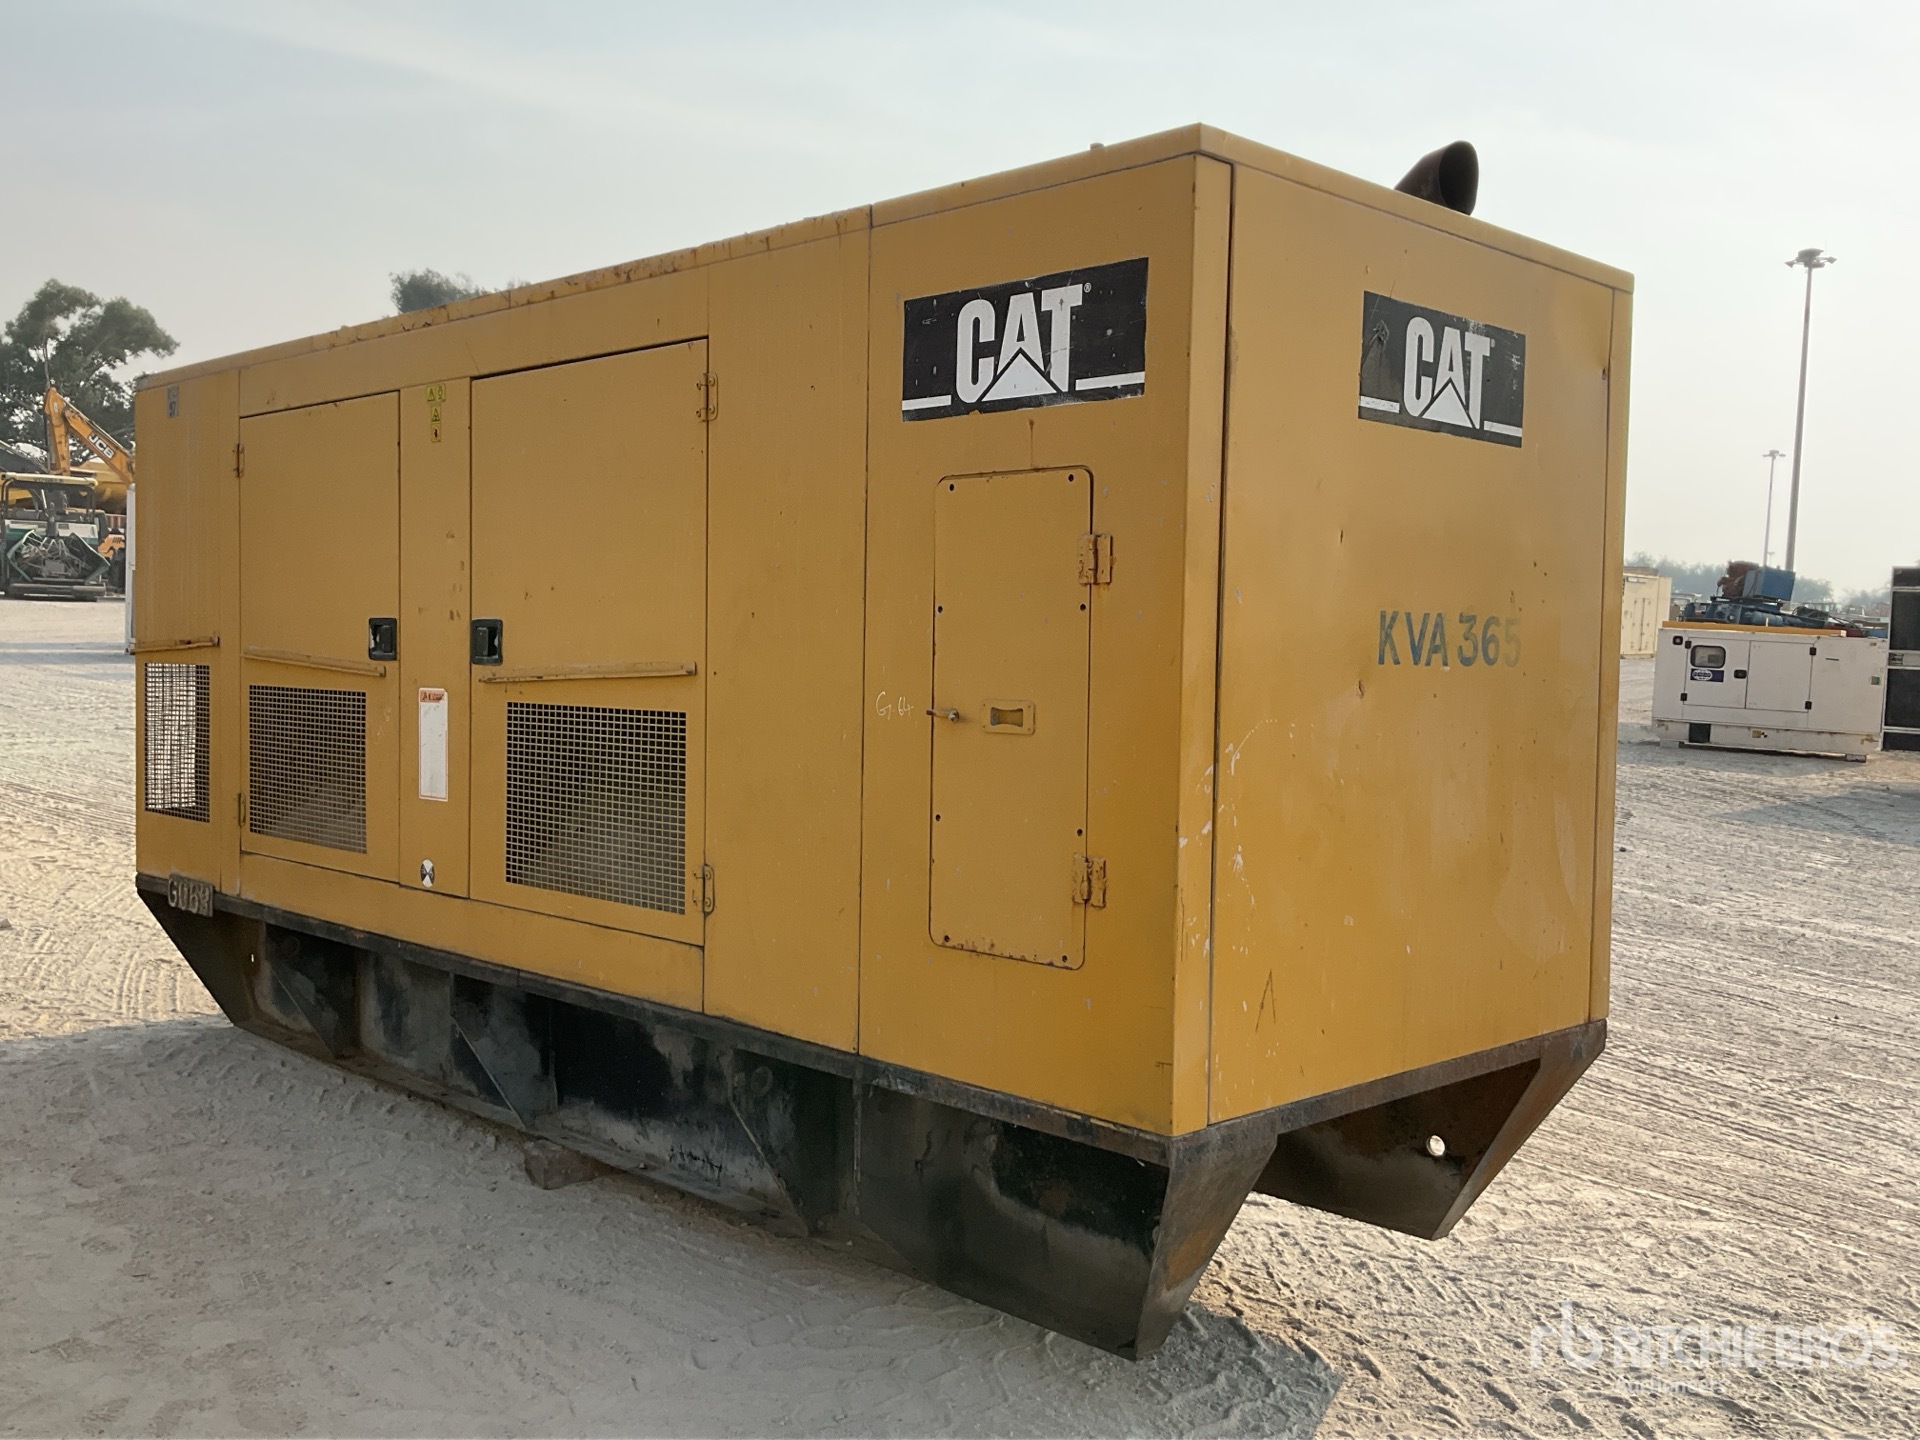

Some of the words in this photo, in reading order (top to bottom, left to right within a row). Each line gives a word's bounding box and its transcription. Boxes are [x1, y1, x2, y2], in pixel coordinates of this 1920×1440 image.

[956, 284, 1083, 404] CAT
[1403, 316, 1491, 429] CAT
[88, 433, 115, 459] JCB
[1378, 610, 1449, 666] KVA
[1457, 612, 1521, 668] 365
